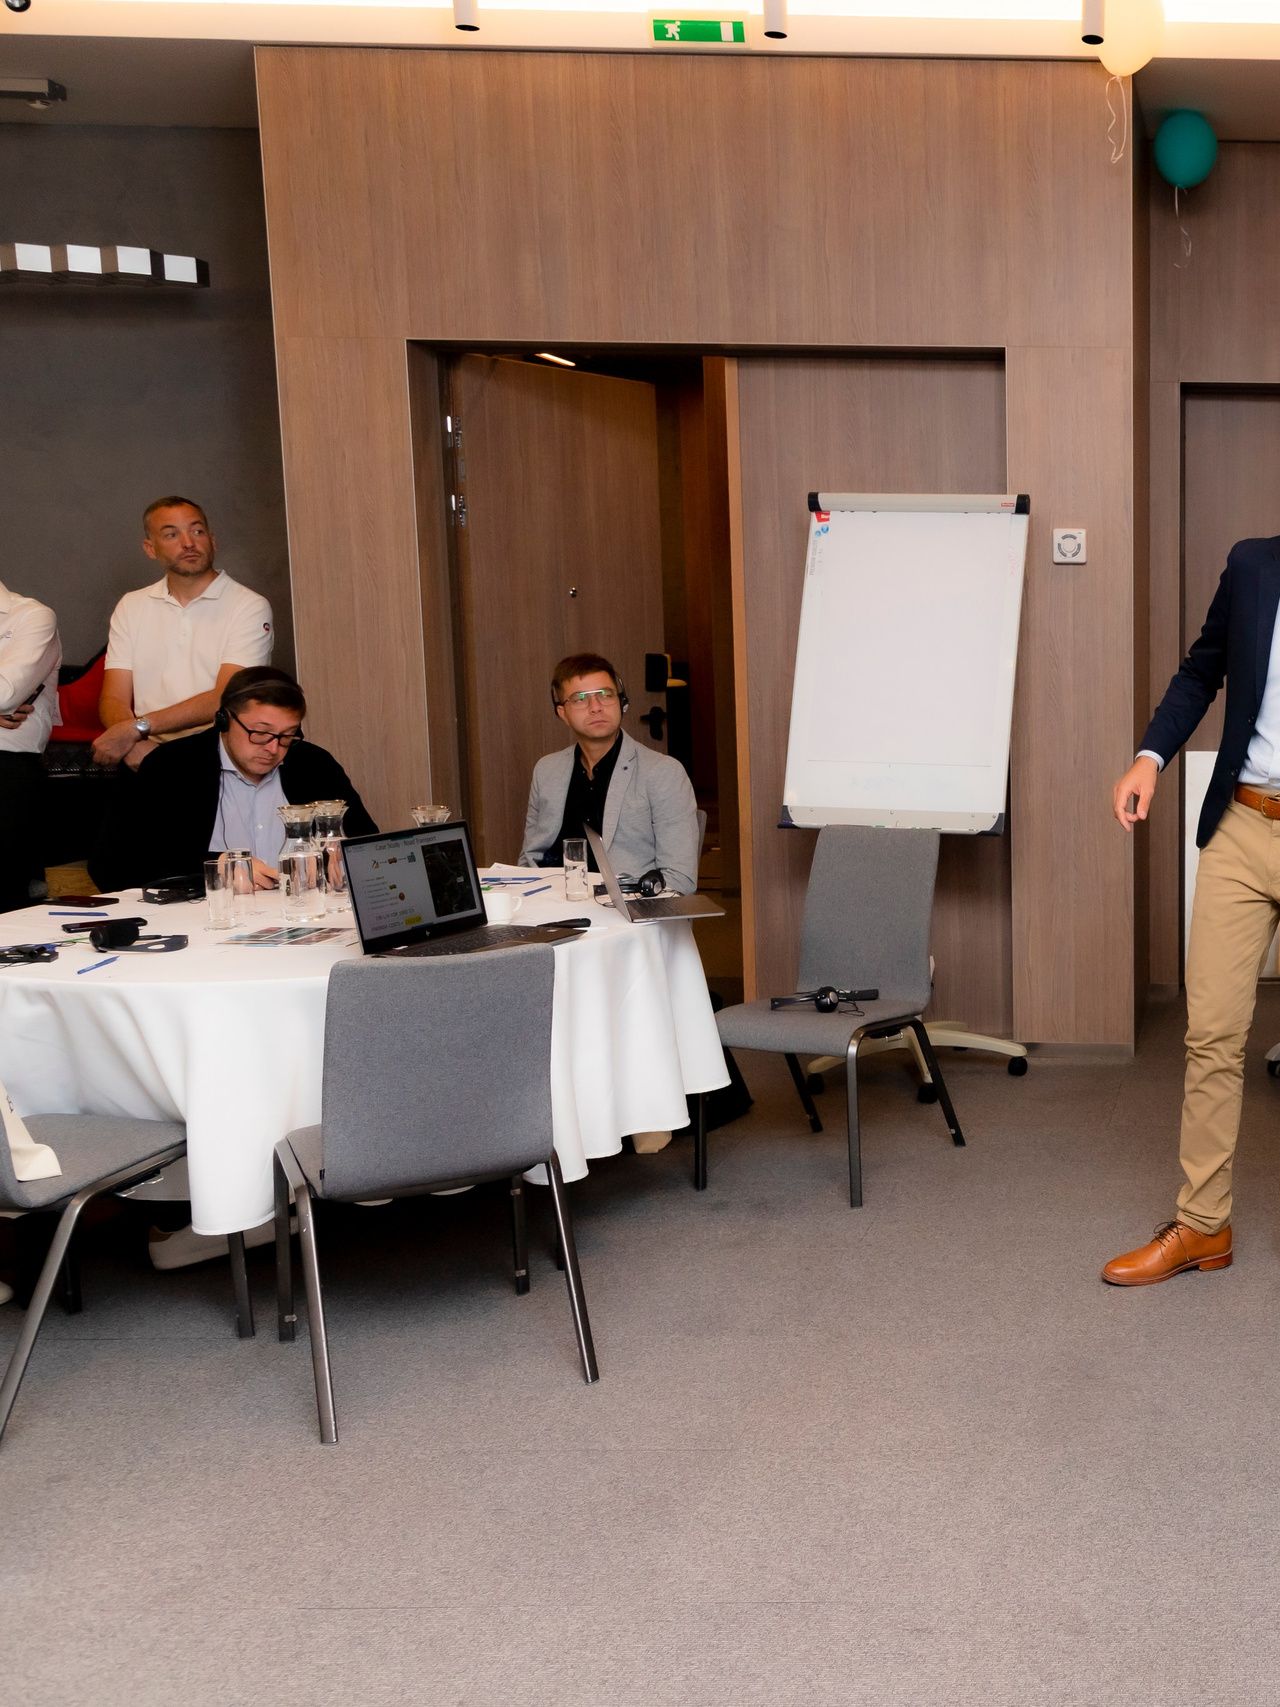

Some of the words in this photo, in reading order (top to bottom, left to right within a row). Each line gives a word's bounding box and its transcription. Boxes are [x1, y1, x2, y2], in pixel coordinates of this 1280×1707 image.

[375, 843, 387, 851] Case
[387, 841, 400, 850] Study
[403, 839, 415, 847] Road
[416, 835, 437, 844] Transport
